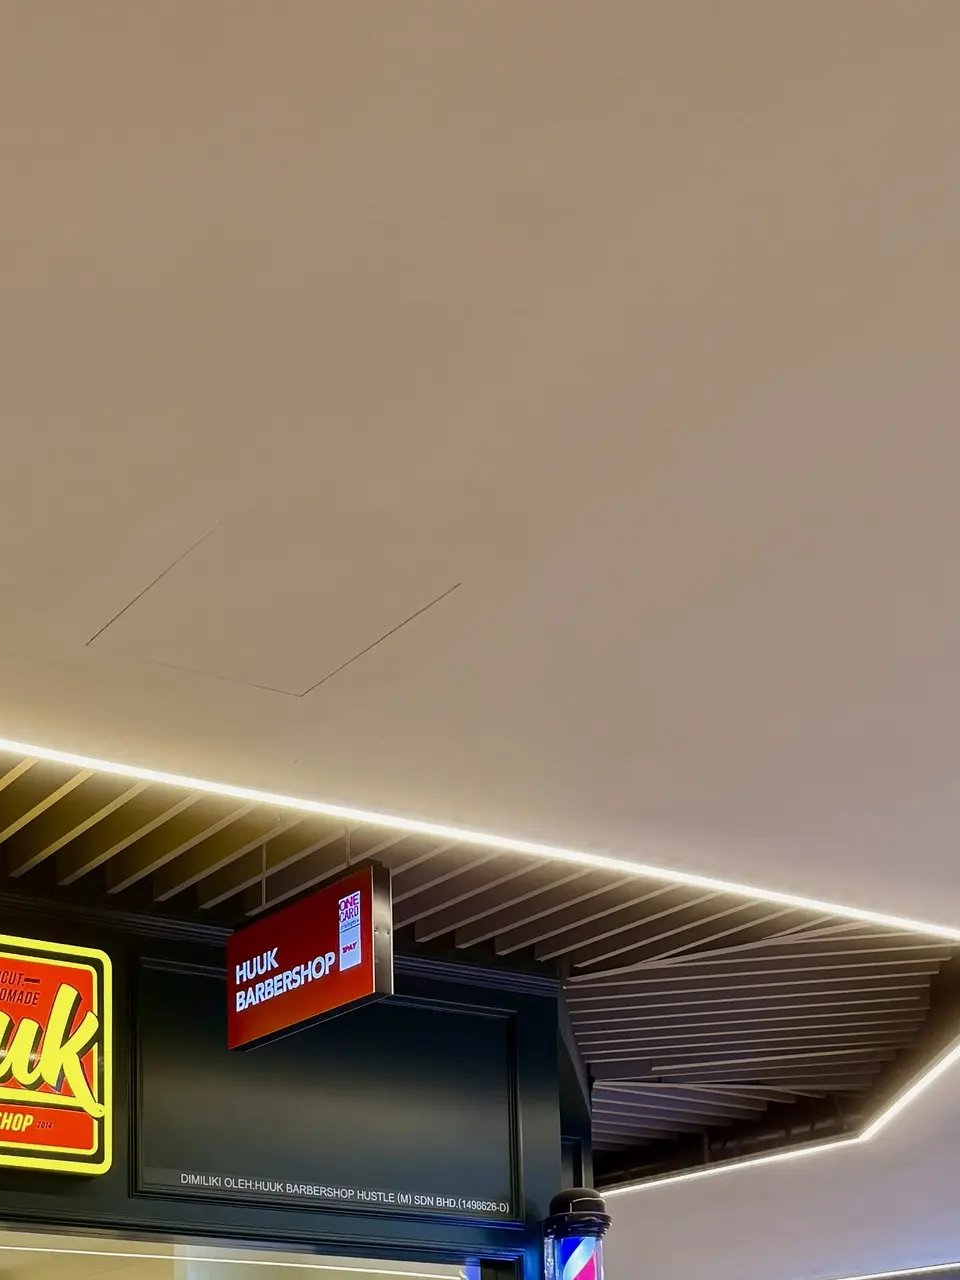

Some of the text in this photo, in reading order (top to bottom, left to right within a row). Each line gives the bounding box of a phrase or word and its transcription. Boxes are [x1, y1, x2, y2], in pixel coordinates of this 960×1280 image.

[340, 893, 359, 911] ONE
[340, 906, 359, 923] CARD
[235, 947, 279, 985] HUUK
[236, 952, 336, 1012] BARBERSHOP
[36, 1120, 53, 1130] 2014
[180, 1173, 222, 1187] DIMILIKI
[286, 1183, 354, 1199] BARBERSHOP
[357, 1190, 395, 1203] HUSTLE
[397, 1192, 412, 1205] (M)
[414, 1195, 434, 1206] SDN
